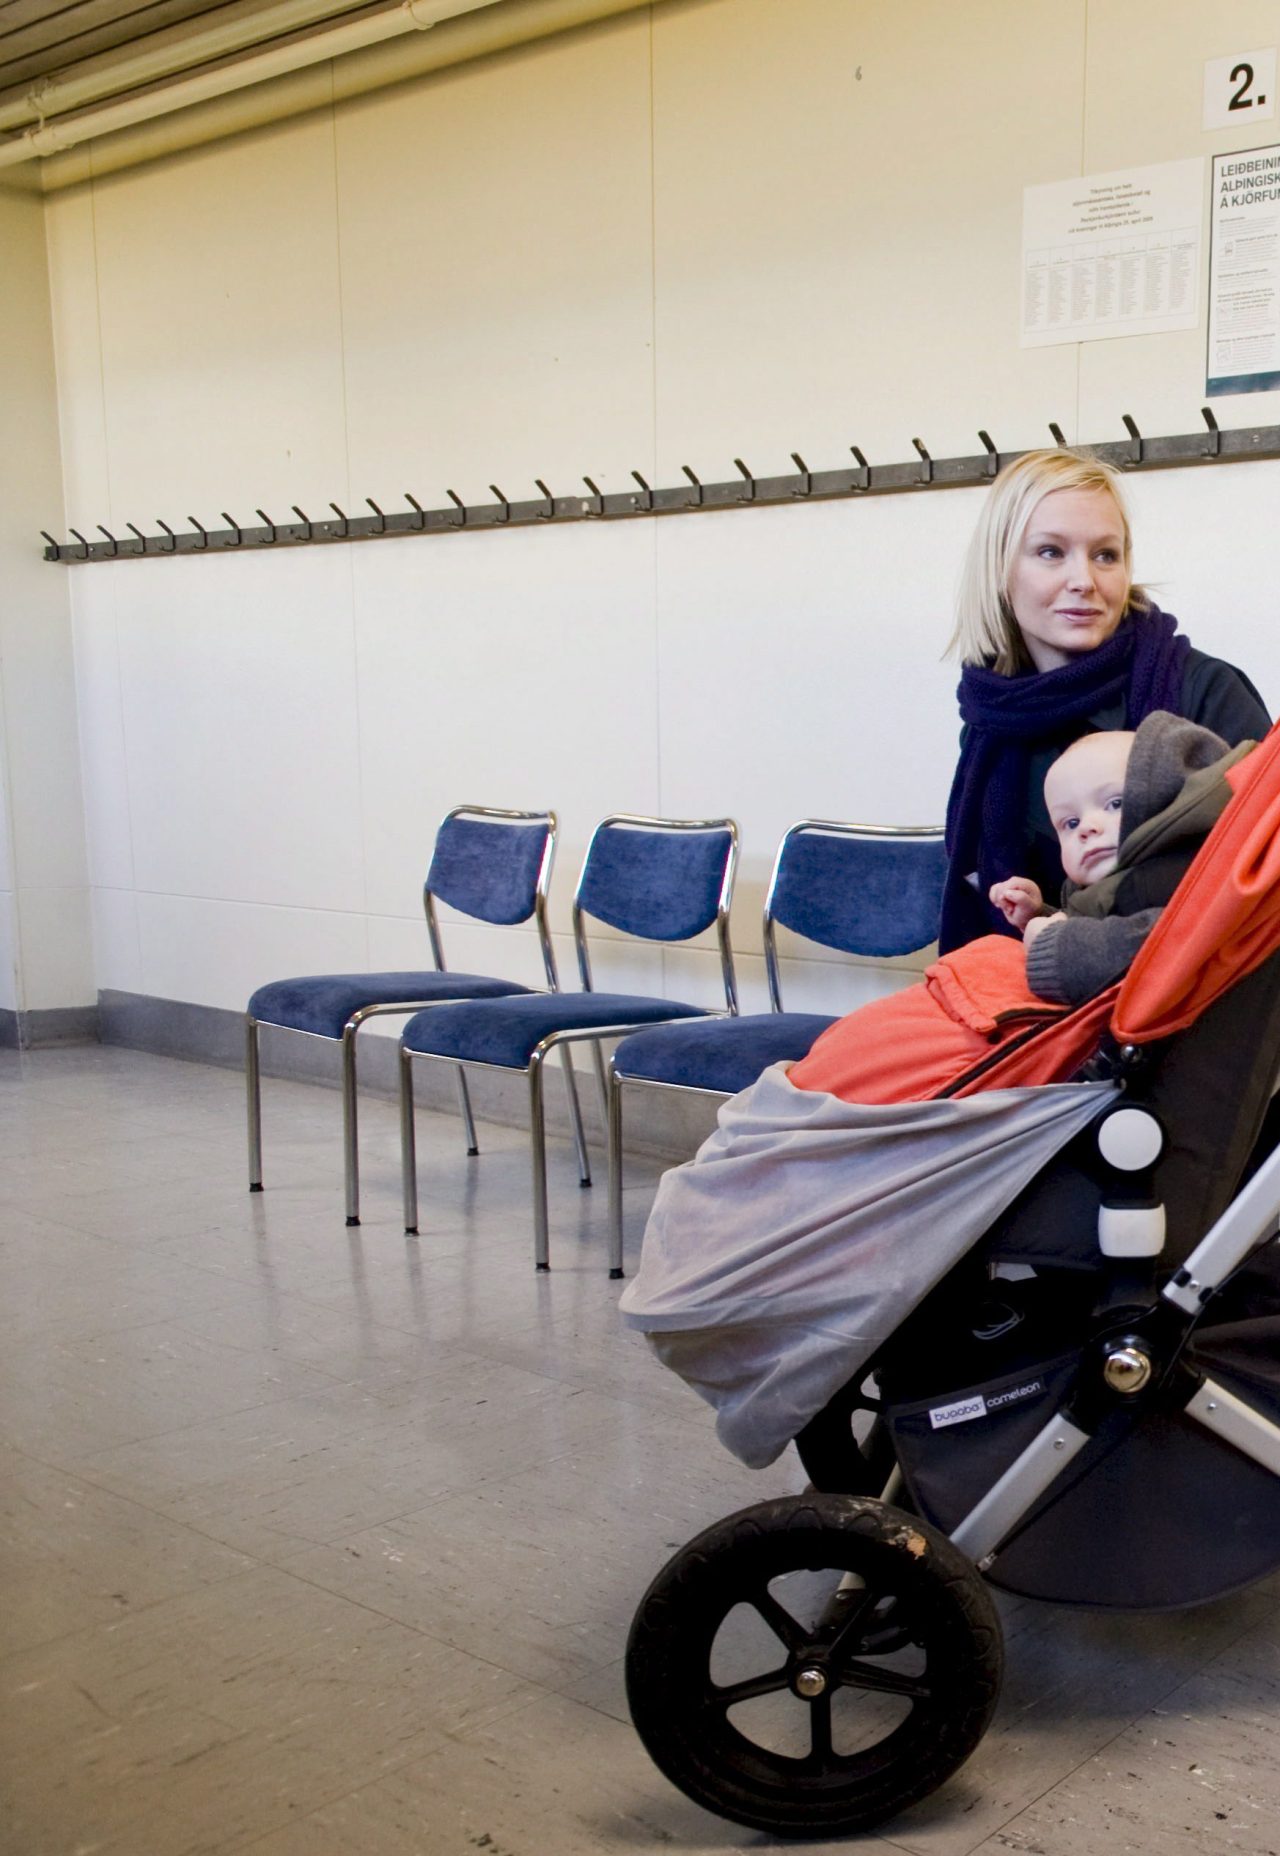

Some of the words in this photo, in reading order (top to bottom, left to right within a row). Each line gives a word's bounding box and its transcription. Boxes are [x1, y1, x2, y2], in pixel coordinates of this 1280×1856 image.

[1228, 62, 1266, 111] 2.
[1219, 194, 1229, 209] Á
[986, 1381, 1041, 1408] cameleon
